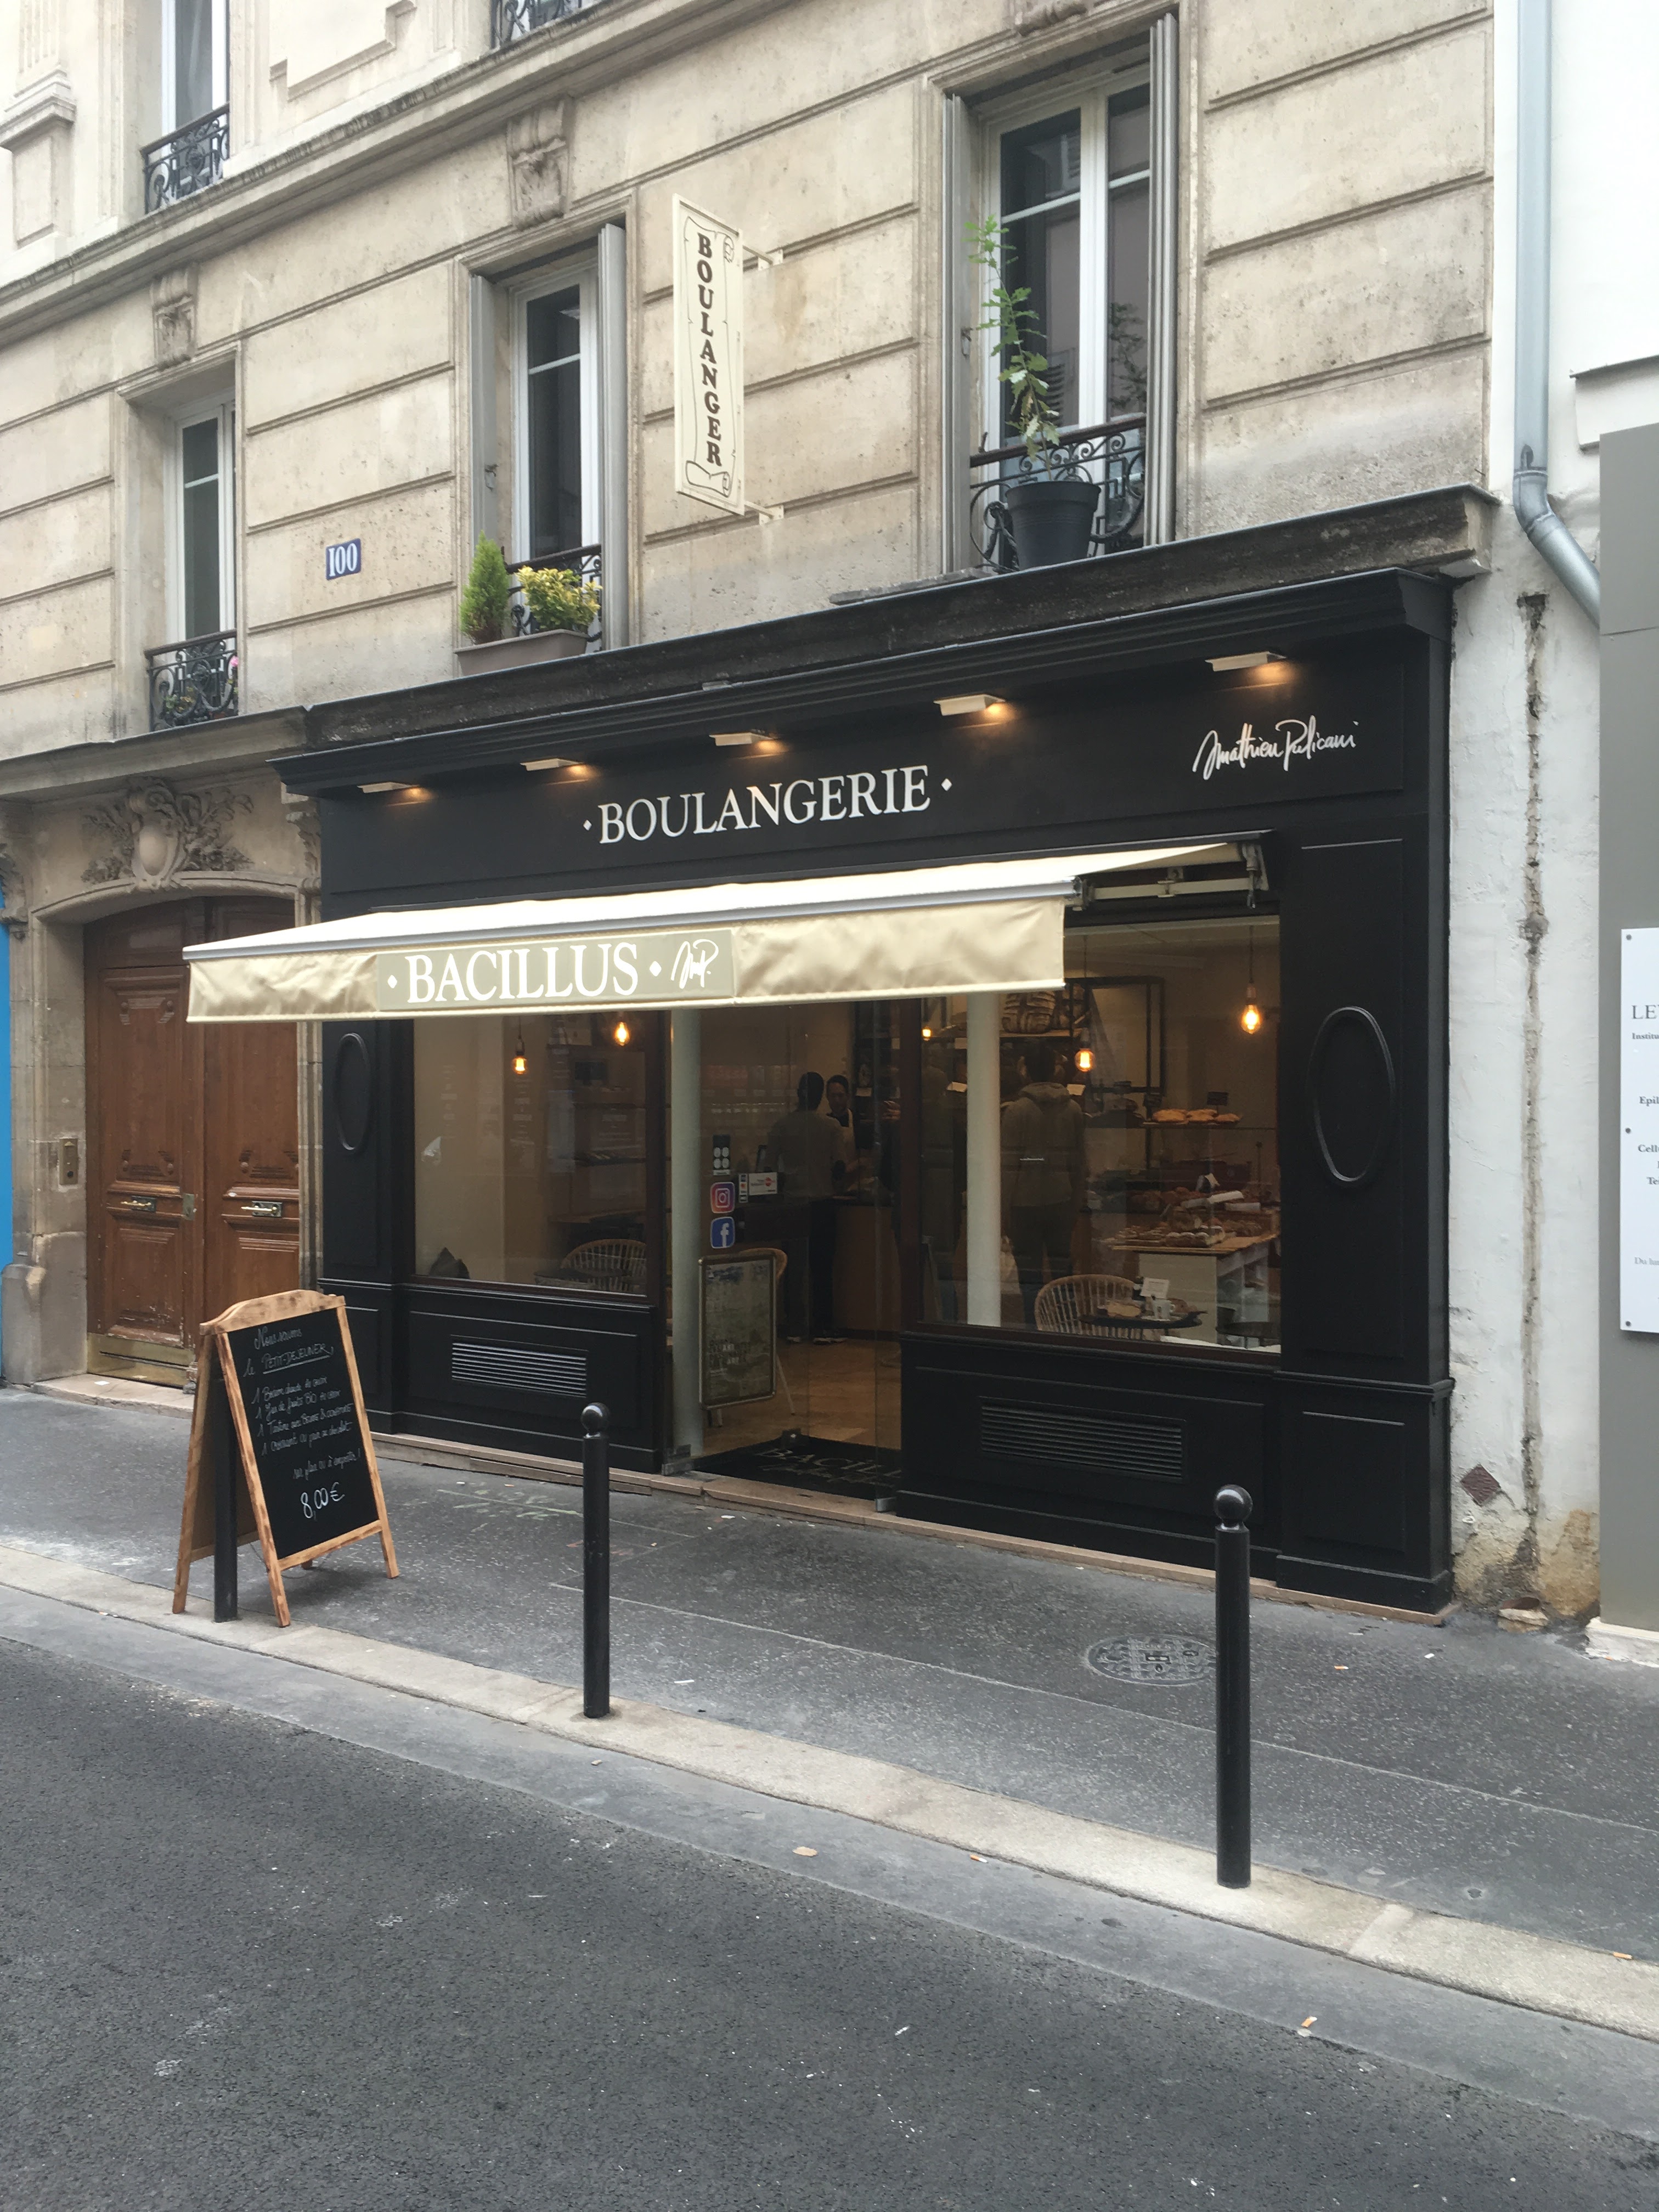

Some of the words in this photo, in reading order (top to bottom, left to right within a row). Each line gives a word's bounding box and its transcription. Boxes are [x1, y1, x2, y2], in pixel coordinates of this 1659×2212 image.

[697, 232, 723, 467] BOULANGER
[329, 543, 358, 577] 100
[598, 765, 931, 844] BOULANGERIE
[405, 942, 639, 1003] BACILLUS
[1631, 1005, 1659, 1019] LE
[1638, 1144, 1659, 1153] Cell
